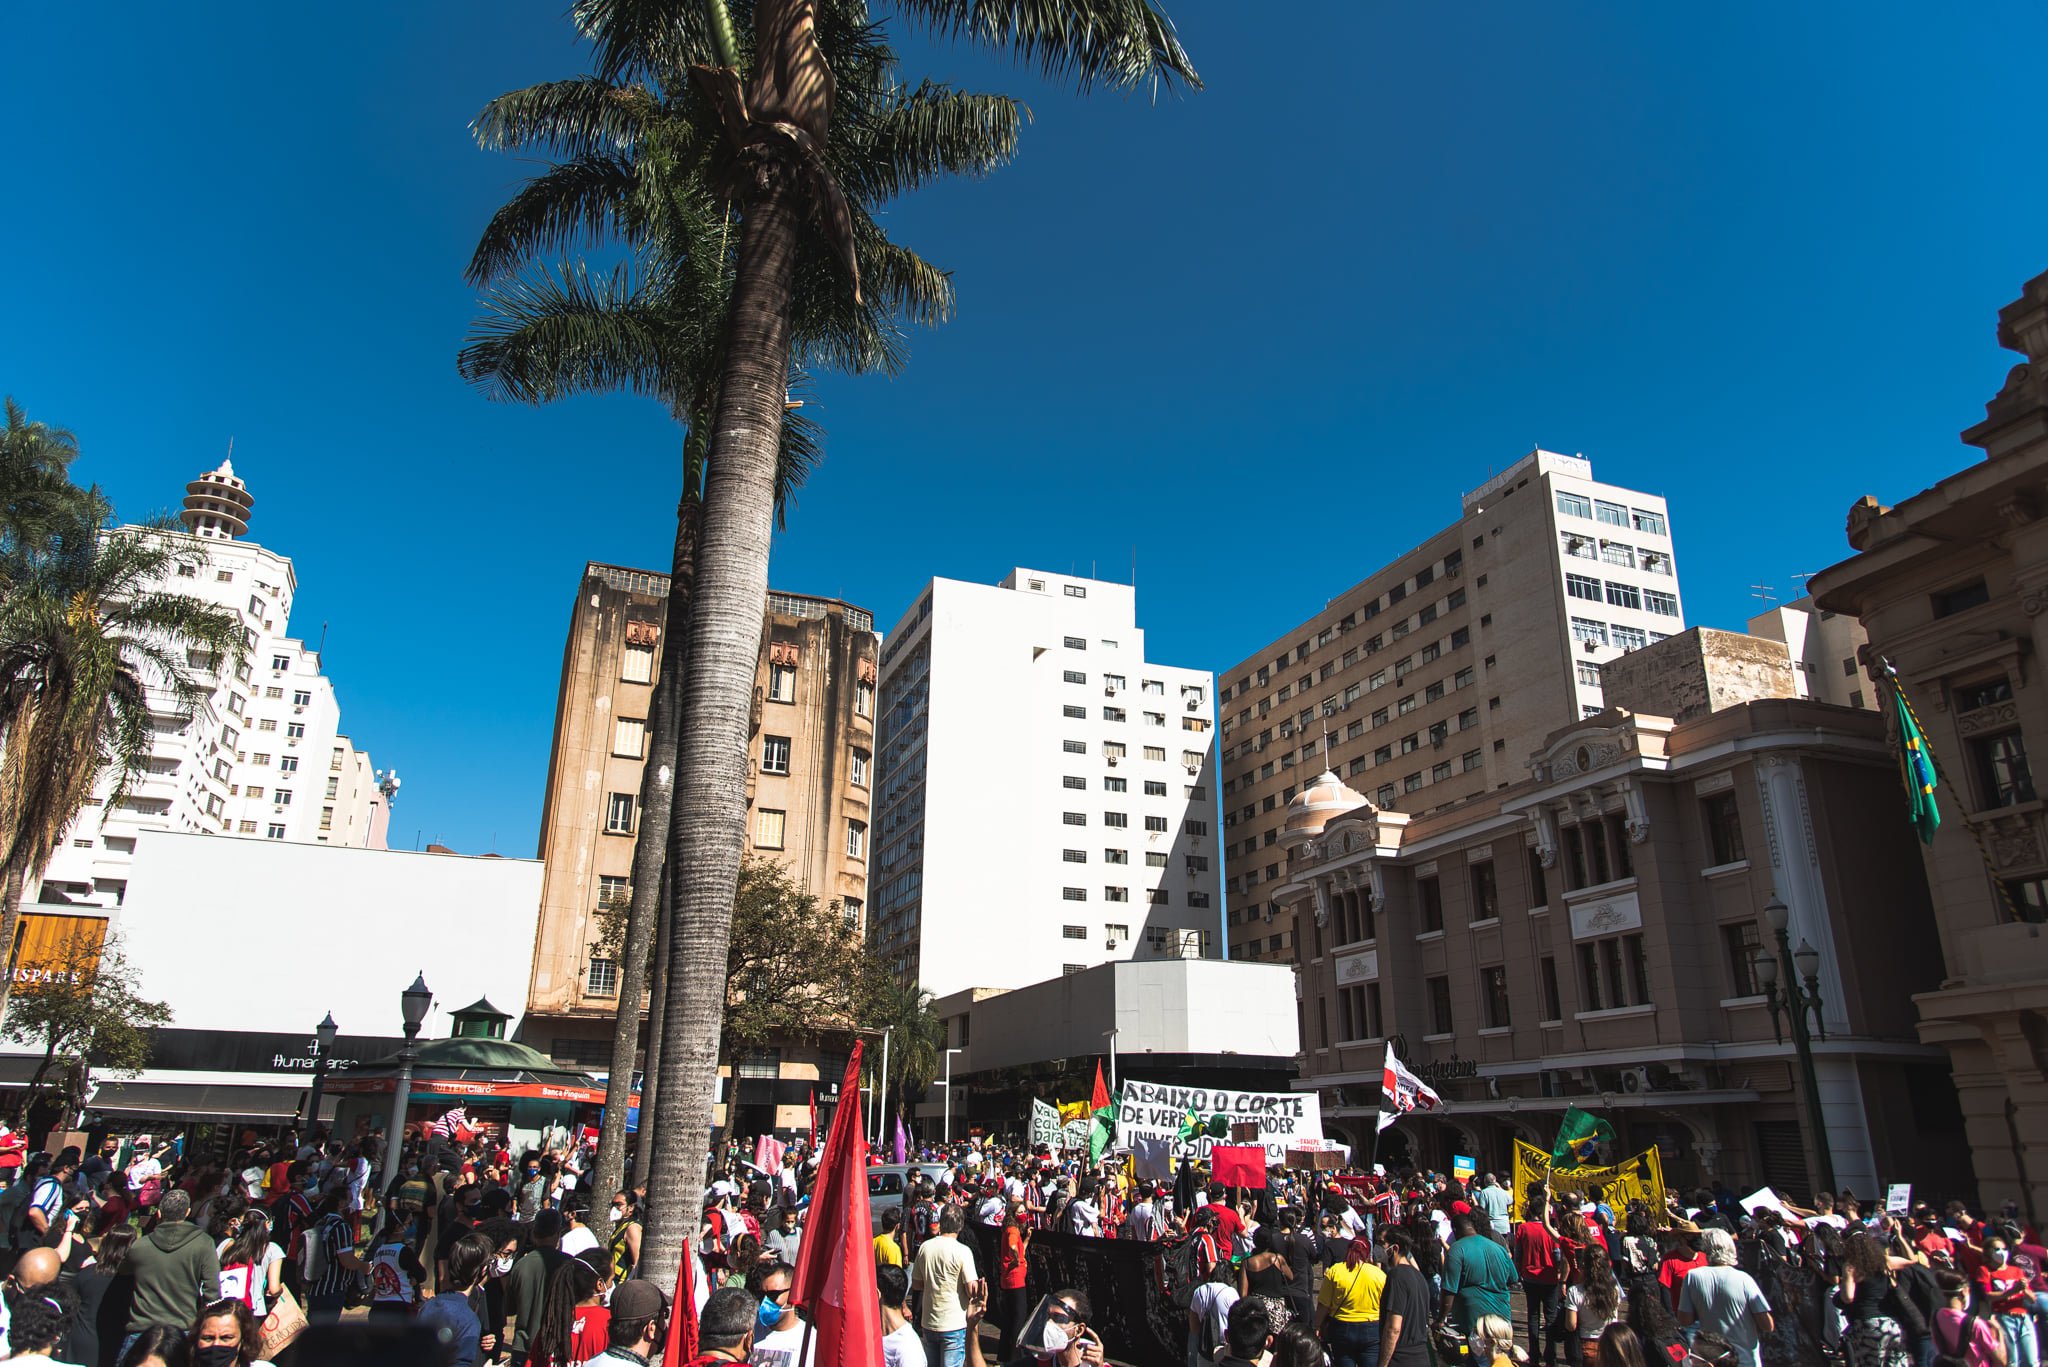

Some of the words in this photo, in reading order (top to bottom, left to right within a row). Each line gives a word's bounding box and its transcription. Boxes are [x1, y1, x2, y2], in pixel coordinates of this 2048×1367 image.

[468, 1085, 492, 1094] Claro
[542, 1087, 563, 1097] Banca
[563, 1089, 591, 1100] Pinguim
[1122, 1082, 1208, 1112] ABAIXO
[1213, 1092, 1229, 1112] O
[1235, 1093, 1303, 1118] CORTE
[1121, 1104, 1144, 1124] DE
[1033, 1130, 1064, 1144] para
